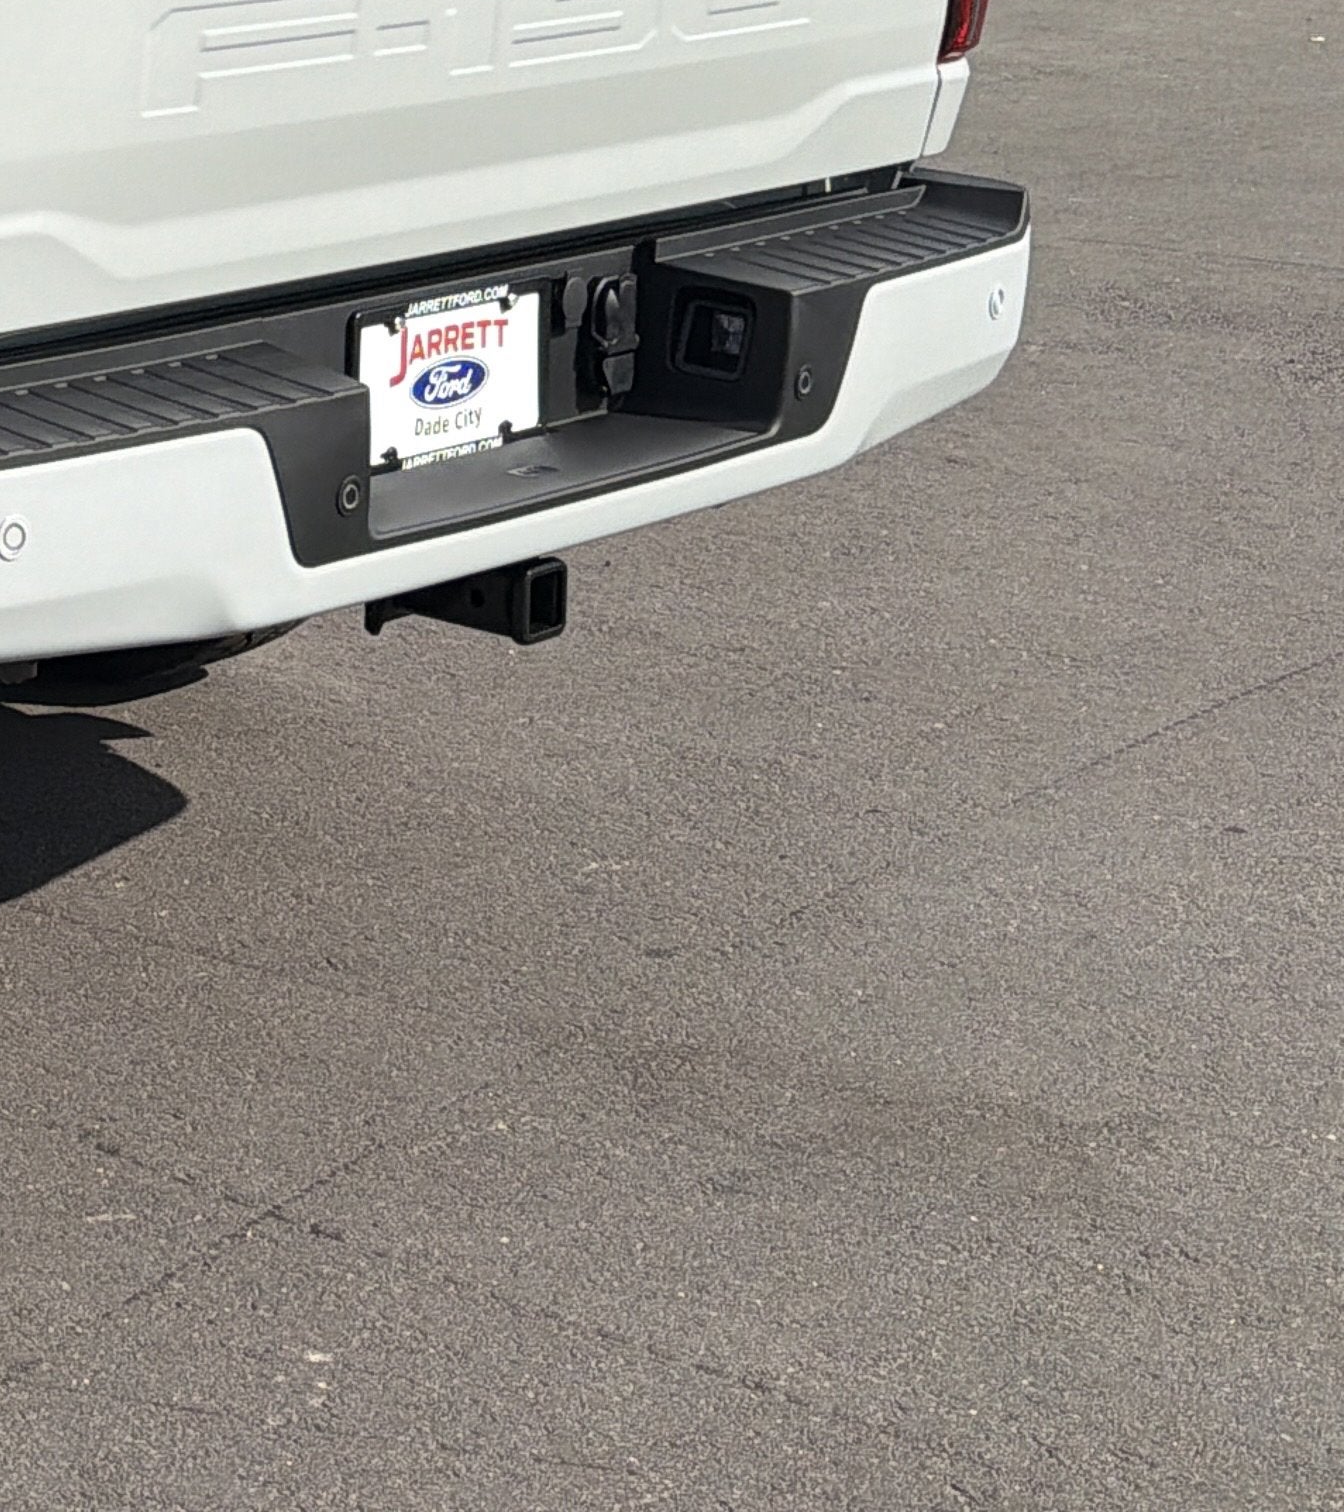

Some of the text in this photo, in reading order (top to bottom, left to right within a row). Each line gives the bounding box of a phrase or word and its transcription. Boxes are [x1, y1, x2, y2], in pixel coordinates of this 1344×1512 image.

[406, 284, 509, 317] JARRETTFORD.COM
[389, 318, 509, 388] JARRETT
[422, 364, 473, 403] Ford
[414, 406, 483, 437] Dade City
